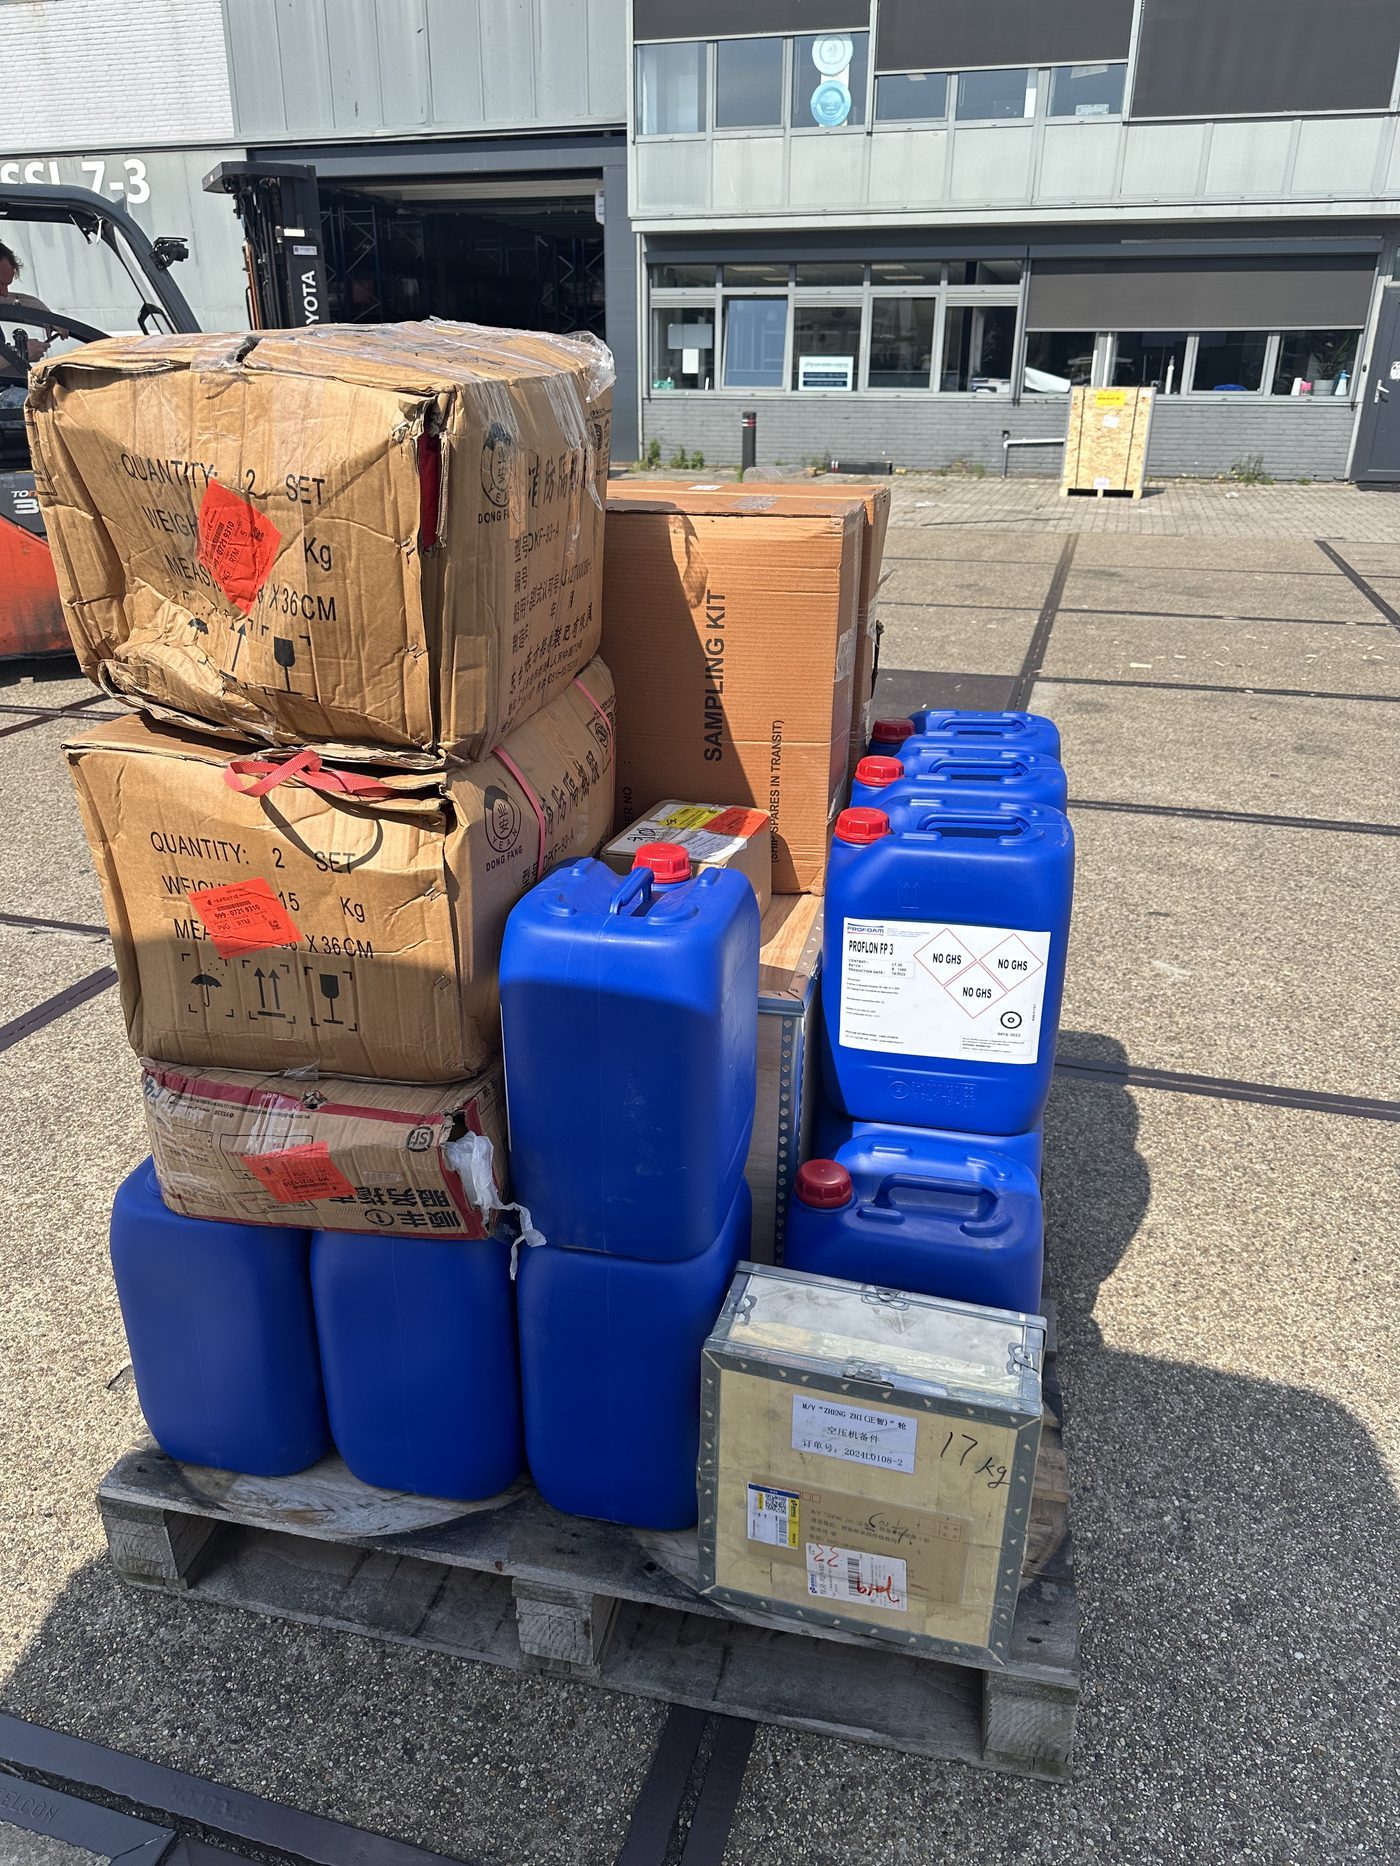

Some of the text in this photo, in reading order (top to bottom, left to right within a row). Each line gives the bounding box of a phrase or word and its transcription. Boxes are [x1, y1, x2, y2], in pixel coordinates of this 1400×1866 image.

[301, 270, 319, 325] YOTA
[246, 469, 256, 497] 2
[285, 473, 325, 505] SET
[477, 508, 502, 524] DONG
[141, 504, 199, 537] WEIGH
[305, 537, 332, 572] Kg
[704, 589, 726, 761] SAMPLING KIT
[769, 719, 784, 863] (SHIP SPARES IN TRANSIT)
[493, 829, 518, 849] YEAN
[150, 831, 356, 874] QUANTITY: 2 SET
[486, 845, 523, 872] DONG FANG
[215, 911, 226, 920] 999
[230, 908, 244, 916] 0721
[244, 904, 261, 914] 9310
[278, 891, 300, 912] 15
[341, 896, 365, 923] Kg
[848, 940, 894, 955] PROFLON FP 3
[932, 953, 962, 965] NO GHS
[997, 959, 1028, 971] NO GHS
[962, 987, 992, 999] NO GHS
[397, 1210, 461, 1228] 顺丰
[802, 1402, 816, 1411] M/V
[827, 1426, 880, 1443] 空压机备件
[940, 1431, 978, 1466] 17
